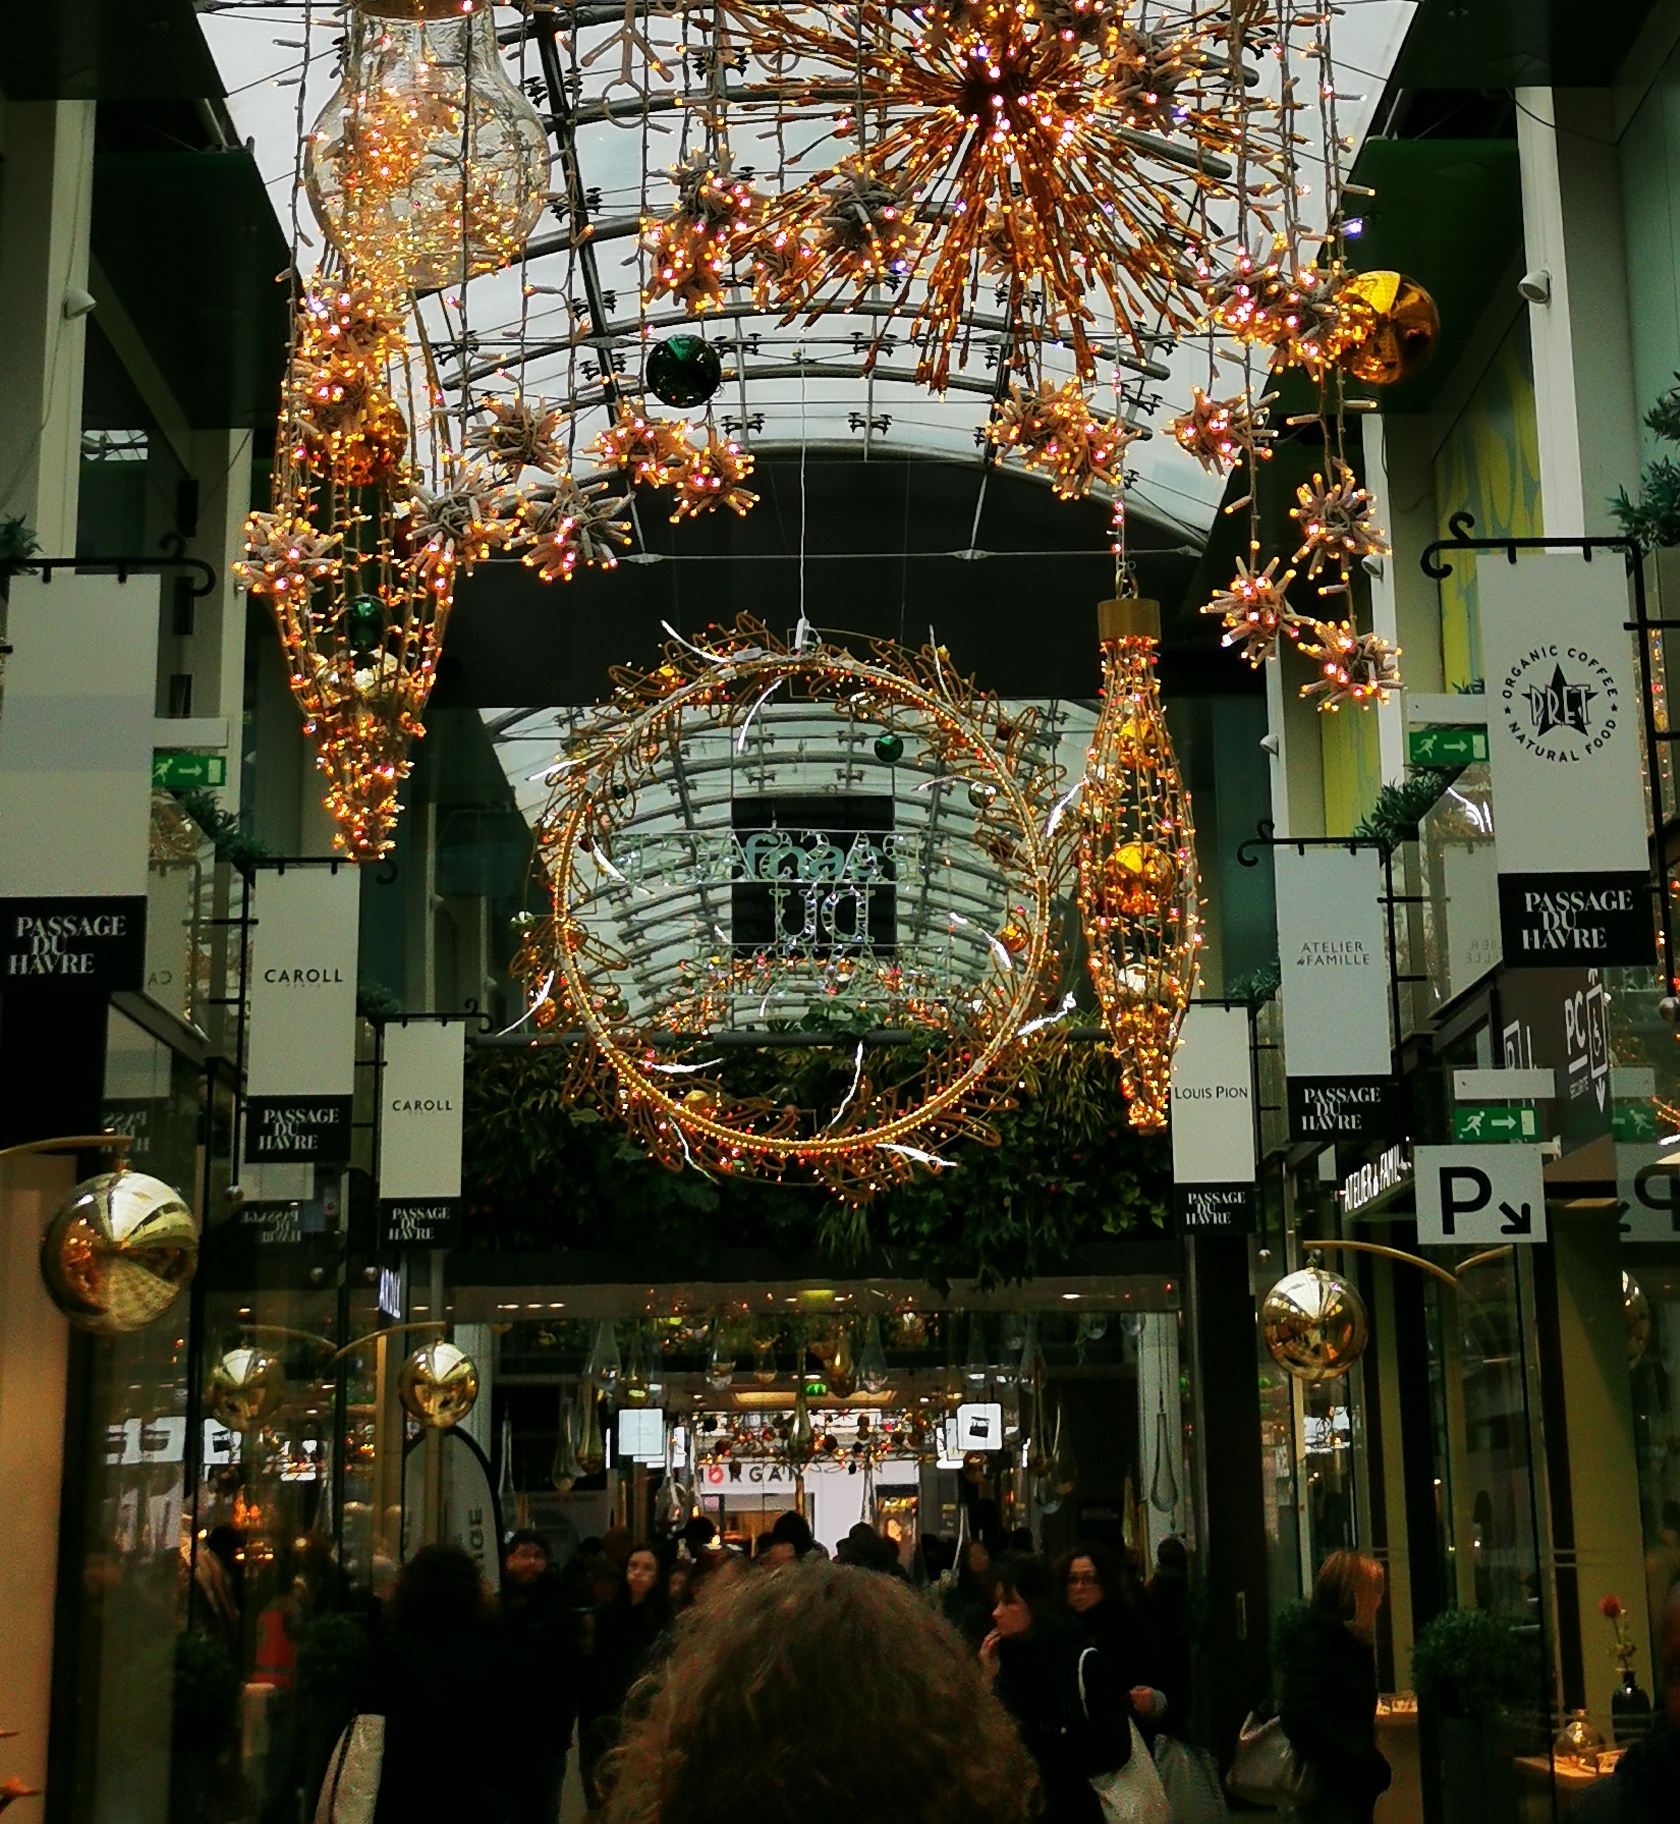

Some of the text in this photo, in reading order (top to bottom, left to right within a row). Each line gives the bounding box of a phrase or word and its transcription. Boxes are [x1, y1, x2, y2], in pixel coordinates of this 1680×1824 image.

[1502, 645, 1618, 699] ORGANIC COFFEE
[1529, 683, 1592, 726] PRET
[1508, 719, 1616, 763] NATURAL FOOD
[1525, 890, 1633, 912] PASSAGE
[16, 915, 126, 937] PASSAGE
[1543, 910, 1577, 930] DU
[32, 935, 67, 955] DU
[1522, 927, 1607, 949] HAVRE
[1301, 941, 1363, 953] ATELIER
[9, 953, 95, 974] HAVRE
[1306, 954, 1370, 966] FAMILLE
[265, 969, 343, 983] CAROLL
[1564, 990, 1586, 1055] PC
[1174, 1085, 1248, 1099] LOUIS PION
[1304, 1087, 1381, 1103] PASSAGE
[392, 1099, 453, 1111] CAROLL
[1316, 1101, 1341, 1117] DU
[263, 1108, 340, 1124] PASSAGE
[1302, 1114, 1362, 1130] HAVRE
[274, 1122, 299, 1136] DU
[258, 1135, 318, 1150] HAVRE
[1188, 1191, 1246, 1204] PASSAGE
[1439, 1166, 1492, 1235] P
[392, 1207, 451, 1220] PASSAGE
[1197, 1202, 1216, 1215] DU
[400, 1218, 420, 1230] DU
[1185, 1212, 1231, 1225] HAVRE
[388, 1228, 434, 1240] HAVRE
